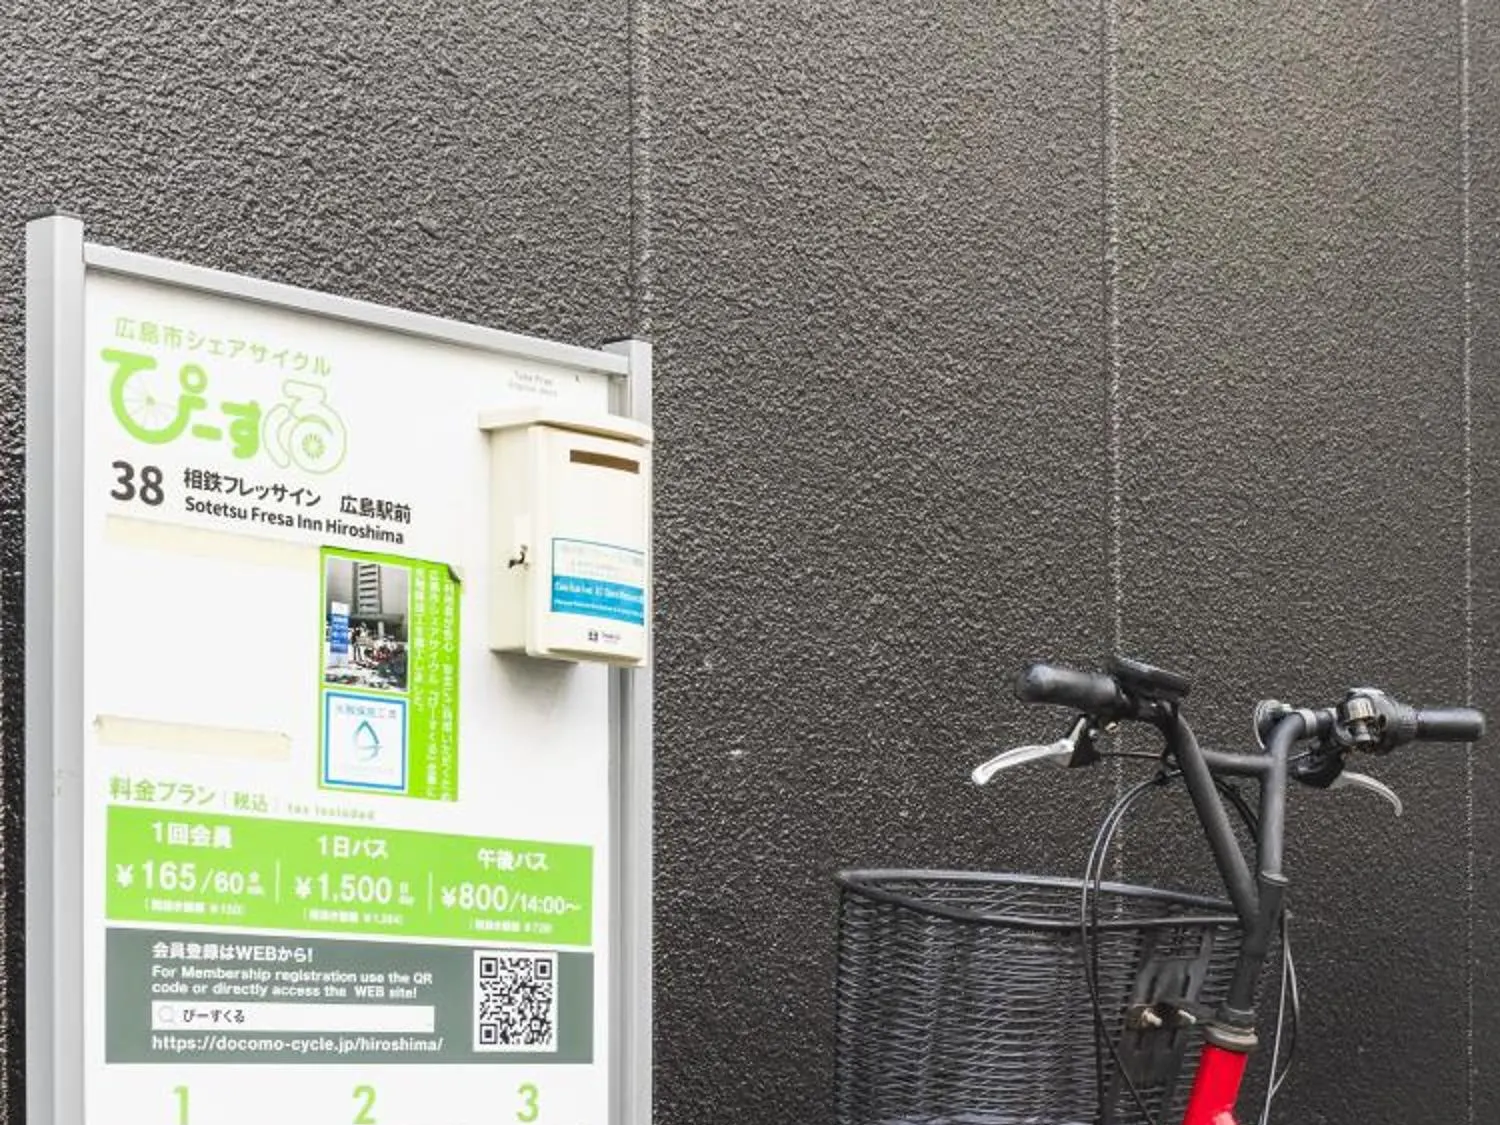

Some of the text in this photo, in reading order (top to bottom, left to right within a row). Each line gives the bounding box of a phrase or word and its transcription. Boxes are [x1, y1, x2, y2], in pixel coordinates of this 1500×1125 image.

[114, 316, 332, 377] 広島市シェアサイクル
[110, 460, 165, 506] 38
[183, 467, 411, 524] 相鉄フレッサイン 広島駅前
[185, 496, 405, 545] Sotetsu Fresa Inn Hiroshima
[110, 775, 216, 806] 料金プラン
[317, 835, 388, 859] 1日パス
[152, 965, 433, 985] For Membership registration use the QR
[152, 981, 188, 994] code
[191, 983, 208, 995] or
[212, 981, 268, 999] directly
[271, 986, 320, 998] access
[323, 984, 347, 998] the
[354, 985, 385, 998] WEB
[152, 1034, 444, 1055] https://docomo-cycle.jp/hiroshima/
[352, 1085, 377, 1125] 2
[516, 1083, 540, 1123] 3
